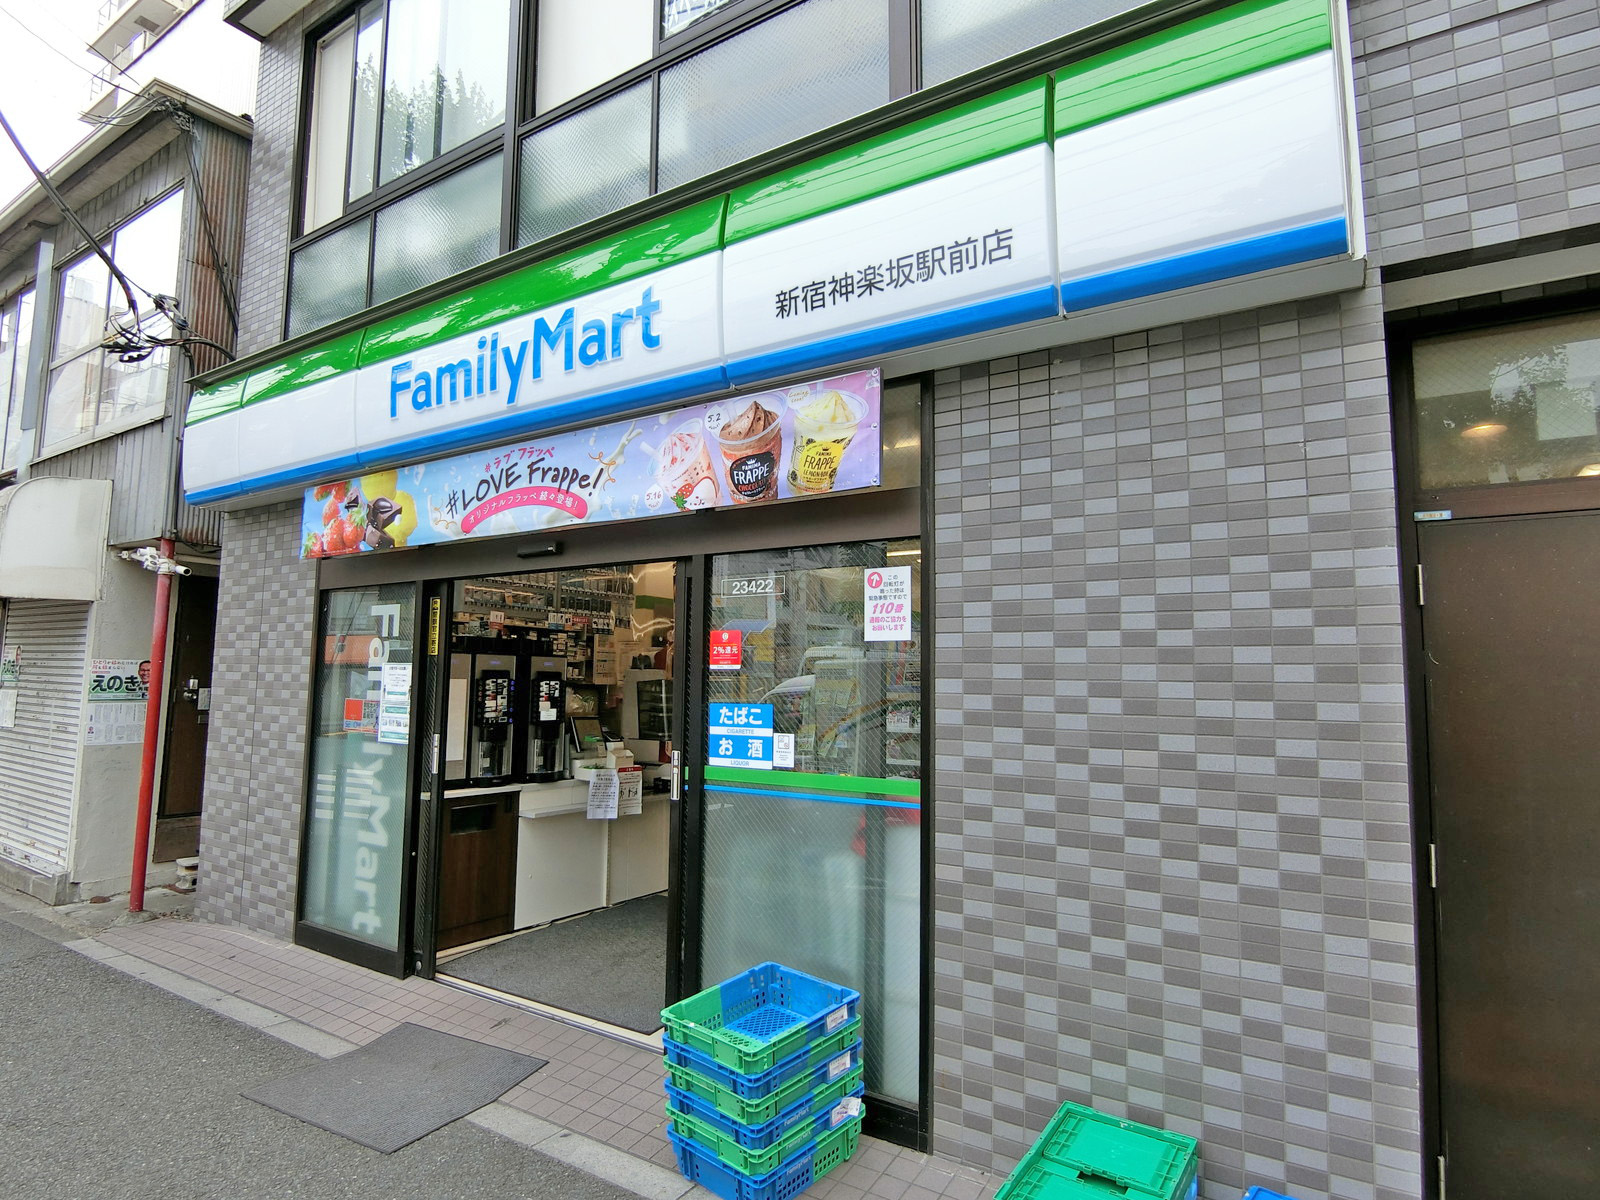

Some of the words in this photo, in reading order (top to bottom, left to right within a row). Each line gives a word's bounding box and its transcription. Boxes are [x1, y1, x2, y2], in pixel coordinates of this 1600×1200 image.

[775, 228, 1013, 319] 新宿神楽坂駅前店
[389, 285, 662, 419] FamilyMart
[707, 412, 721, 423] 5.2
[803, 454, 837, 470] FRAPPE
[733, 462, 770, 485] FRAPPE
[446, 462, 522, 519] #LOVE
[527, 457, 604, 496] Frappe!
[645, 490, 662, 500] 5.16
[732, 579, 774, 595] 23422
[873, 601, 904, 614] 110番
[872, 623, 904, 631] お願いします
[713, 646, 738, 655] 2%還元
[91, 674, 140, 692] えのき
[719, 706, 763, 725] たばこ
